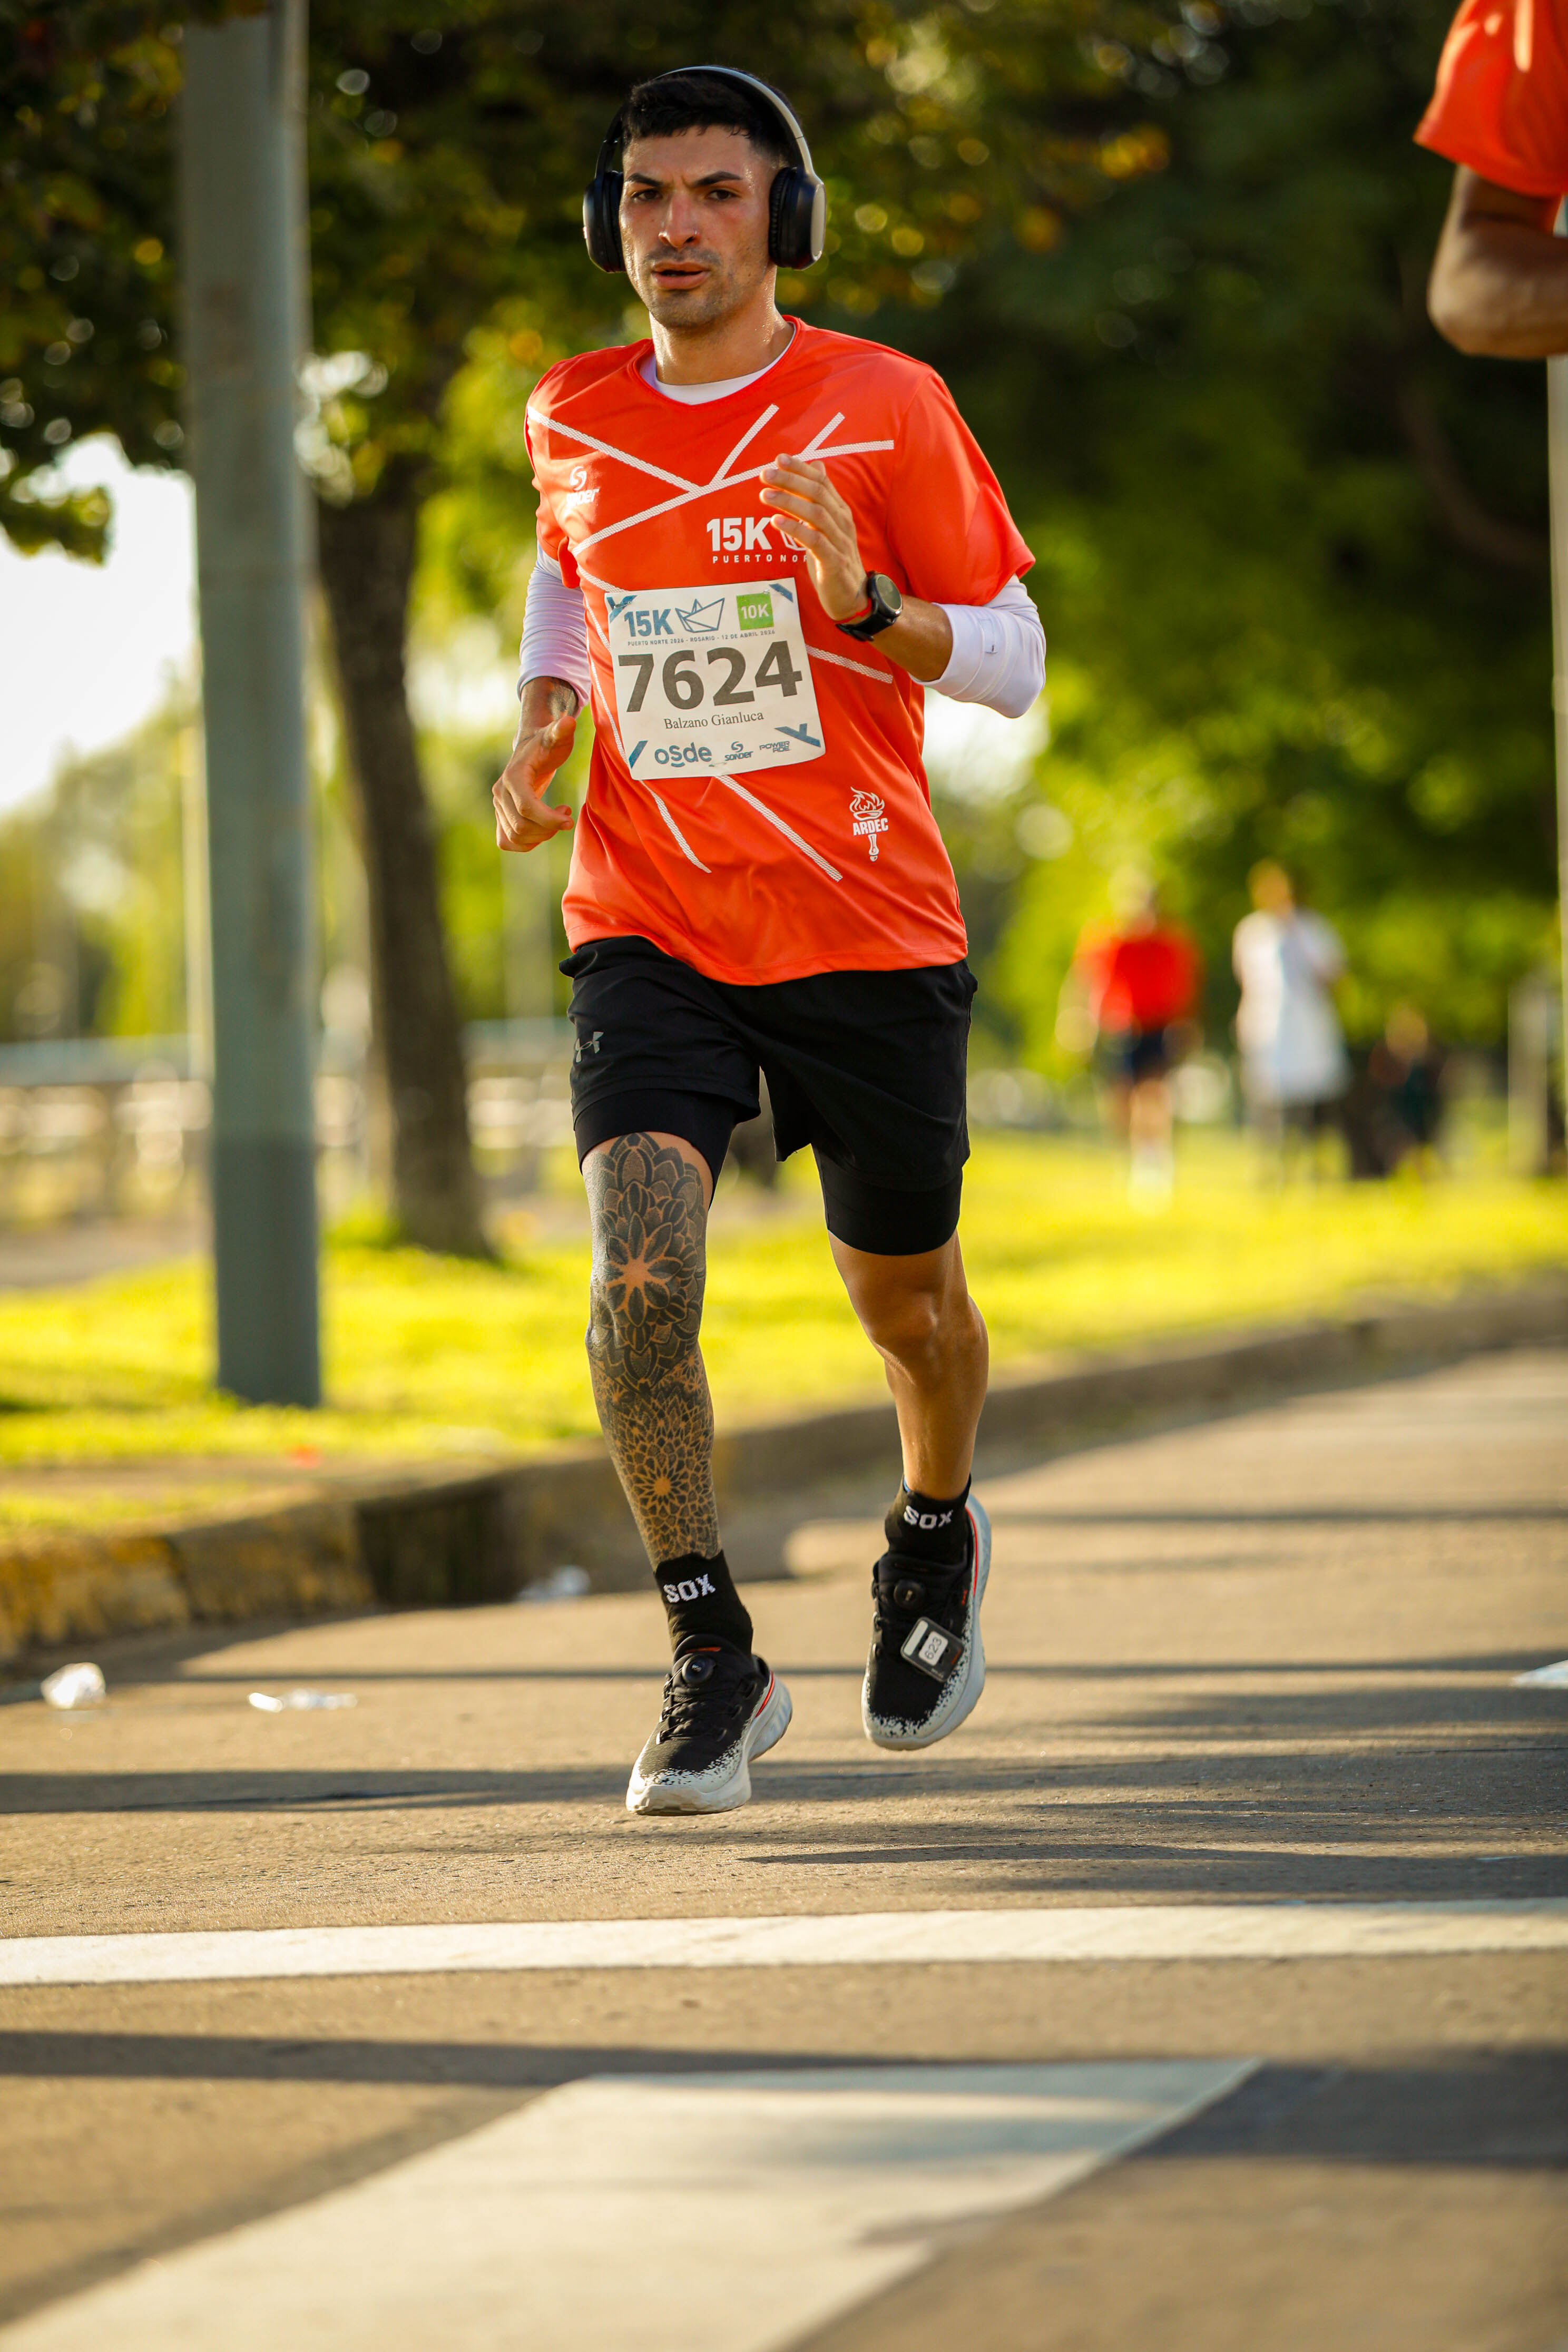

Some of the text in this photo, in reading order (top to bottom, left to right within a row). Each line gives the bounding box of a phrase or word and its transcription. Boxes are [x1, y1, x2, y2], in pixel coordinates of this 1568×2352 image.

[707, 516, 772, 552] 15K
[712, 554, 772, 564] PUERTO
[624, 609, 674, 637] 15K
[741, 604, 769, 620] 10K
[618, 640, 803, 712] 7624
[664, 710, 764, 730] Balzano Gianluca
[654, 742, 712, 764] osde
[759, 741, 790, 750] POWER
[852, 818, 889, 836] ARDEC
[903, 1505, 954, 1530] SOX
[663, 1573, 716, 1603] SOX
